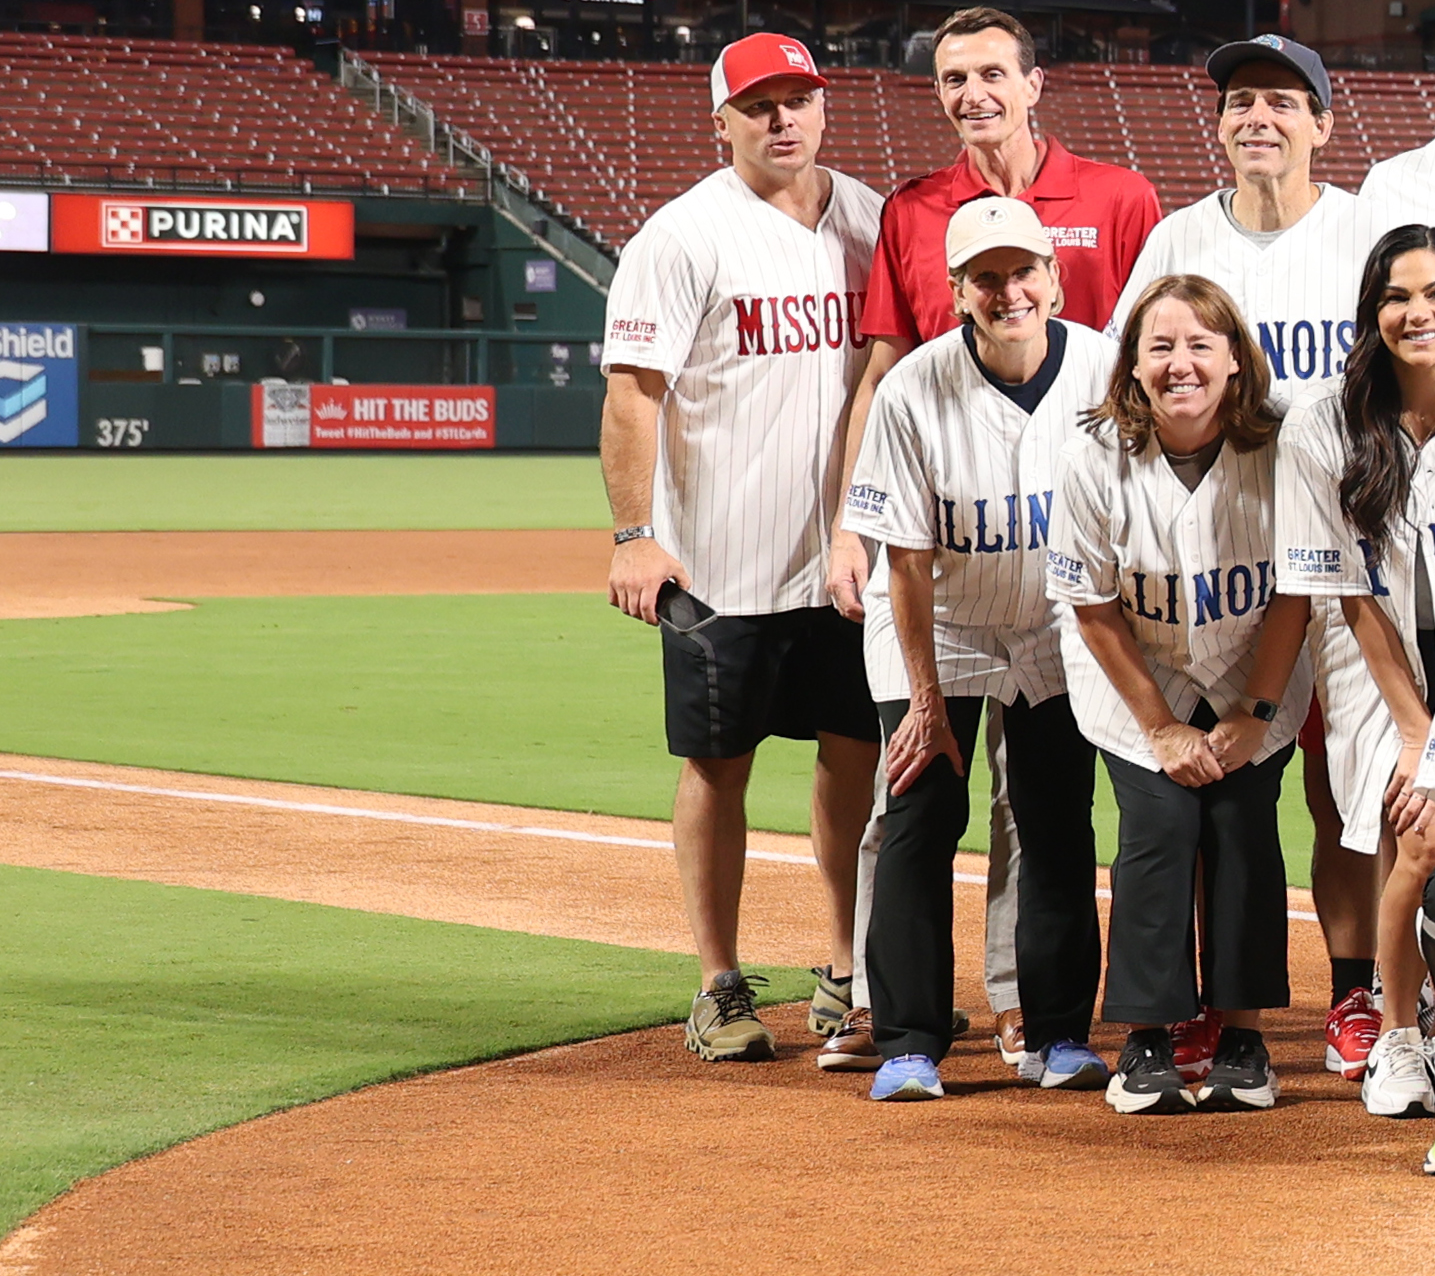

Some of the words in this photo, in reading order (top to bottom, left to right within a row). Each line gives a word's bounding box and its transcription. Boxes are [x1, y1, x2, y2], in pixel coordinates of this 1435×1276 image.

[149, 208, 296, 242] PURINA
[1042, 227, 1098, 240] GREATER
[612, 319, 657, 335] GREATER
[0, 327, 74, 359] hield
[354, 398, 388, 421] HIT
[391, 398, 430, 422] THE
[434, 398, 489, 422] BUDS
[97, 417, 149, 447] 375'
[315, 427, 345, 440] Tweet
[414, 428, 432, 441] and
[1287, 547, 1341, 563] GREATER
[1298, 563, 1323, 573] LOUIS
[1324, 563, 1344, 574] INC.
